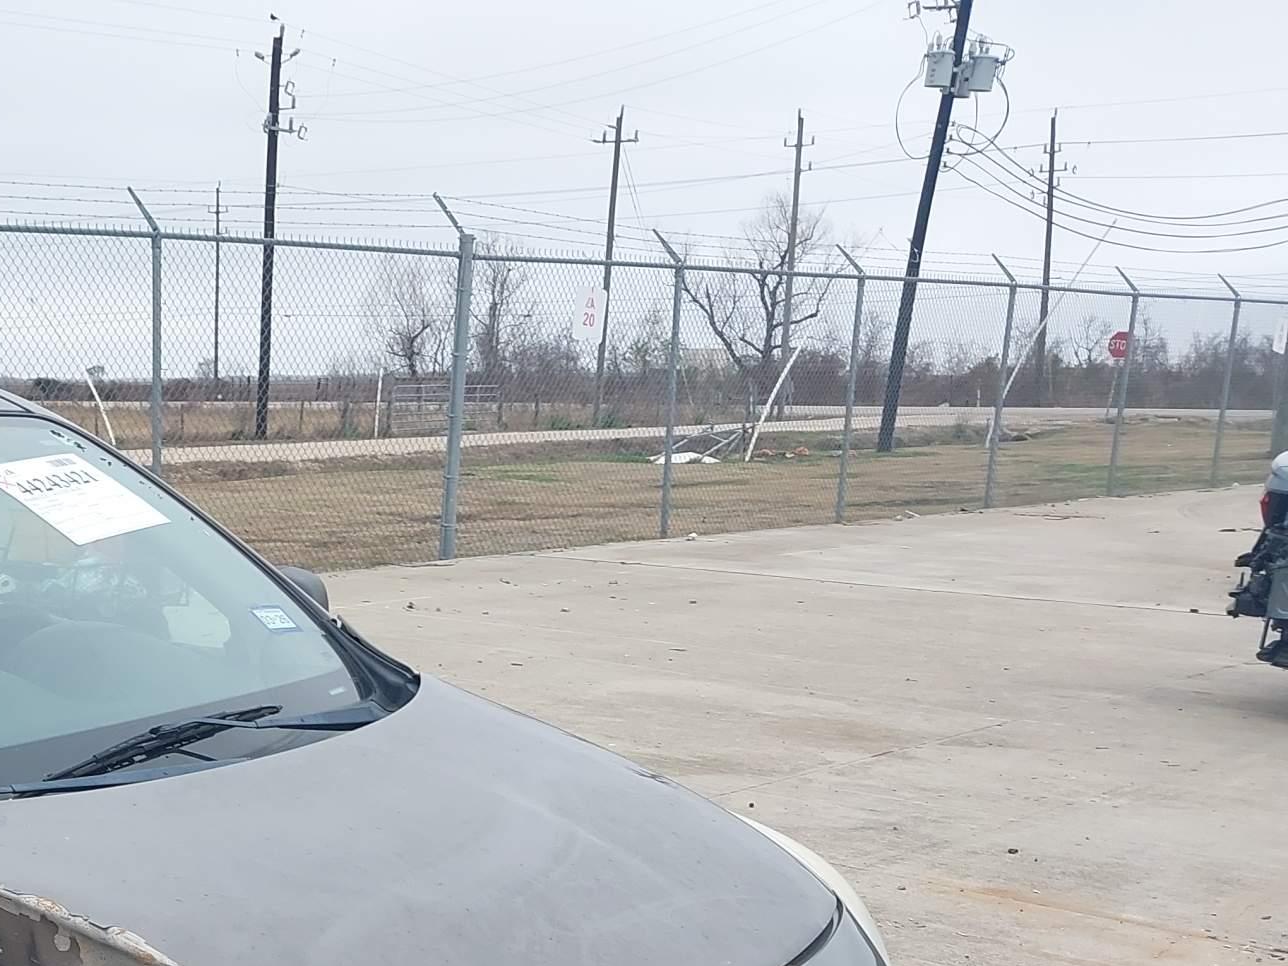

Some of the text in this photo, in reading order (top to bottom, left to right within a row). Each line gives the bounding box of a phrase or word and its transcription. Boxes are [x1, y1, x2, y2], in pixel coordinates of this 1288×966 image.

[583, 312, 595, 327] 20
[1109, 340, 1127, 350] STO
[16, 470, 99, 496] 44243421
